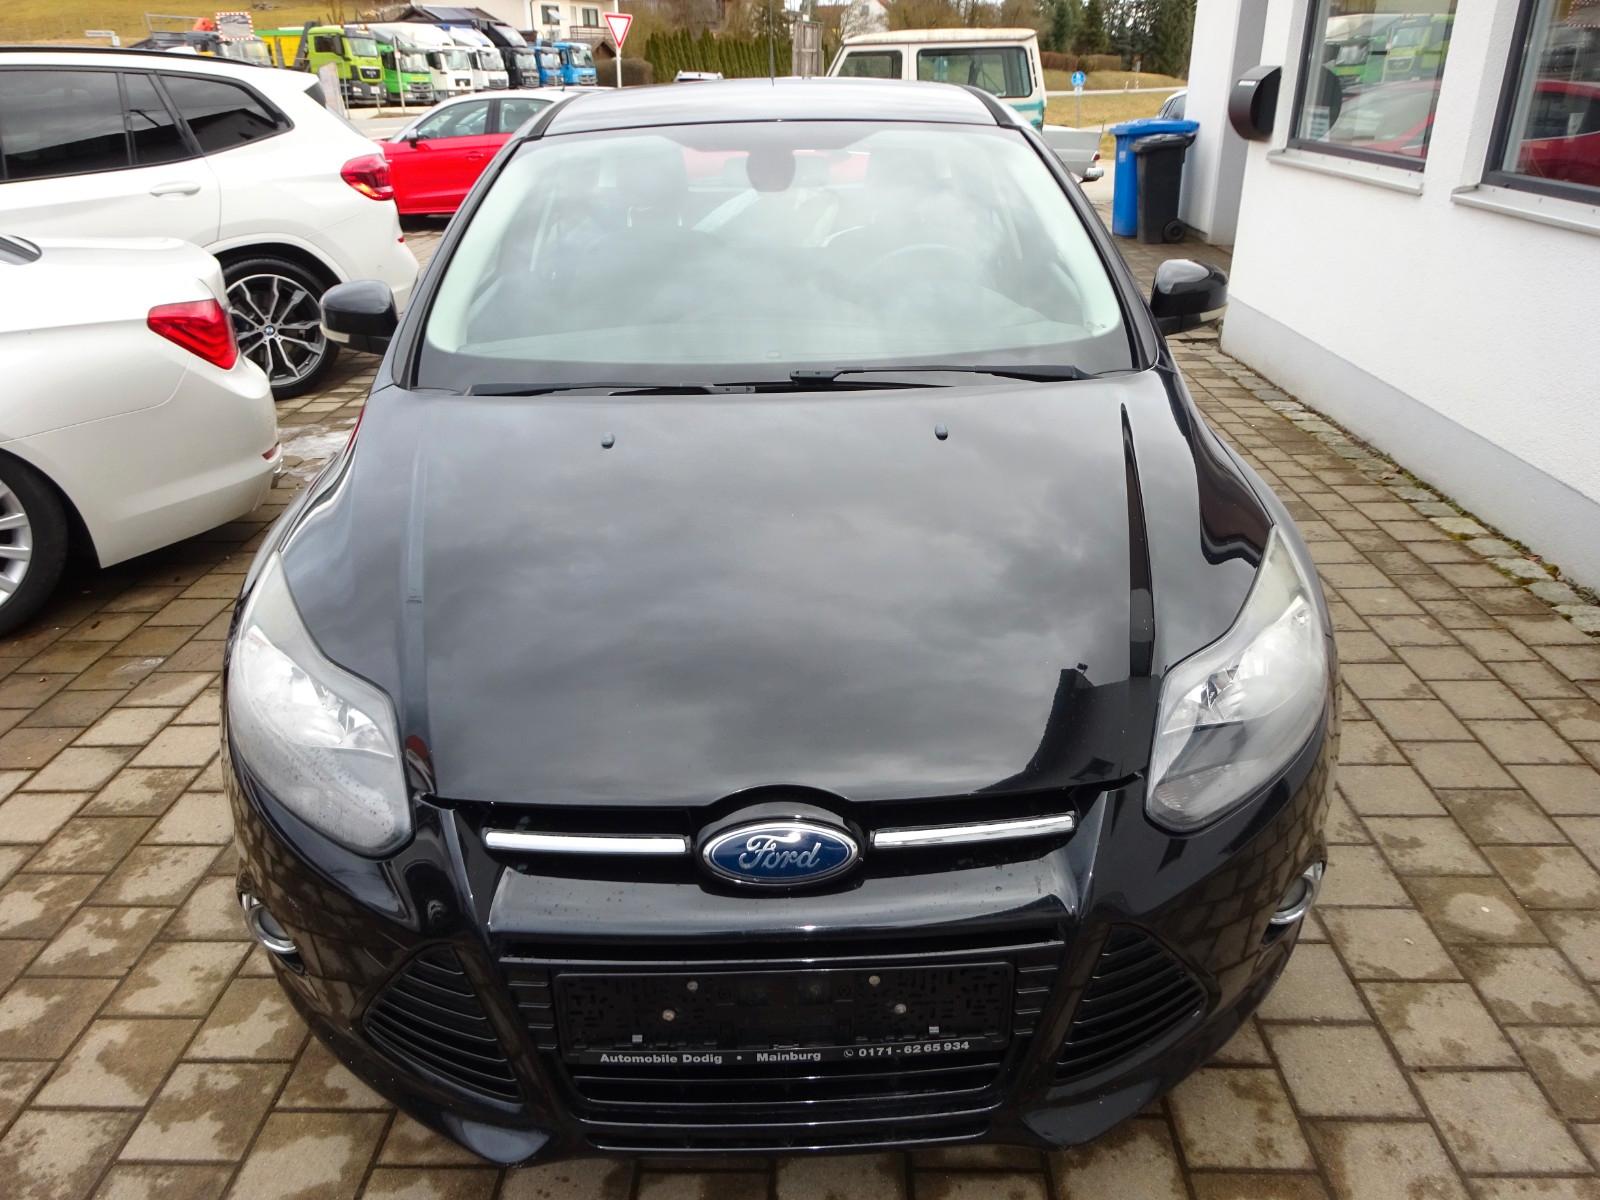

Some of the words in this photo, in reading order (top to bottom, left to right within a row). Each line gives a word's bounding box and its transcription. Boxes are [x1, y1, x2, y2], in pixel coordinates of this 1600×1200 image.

[738, 831, 822, 870] Ford
[600, 1053, 678, 1063] Automobile
[682, 1053, 723, 1064] Dodig
[756, 1052, 821, 1063] Mainburg
